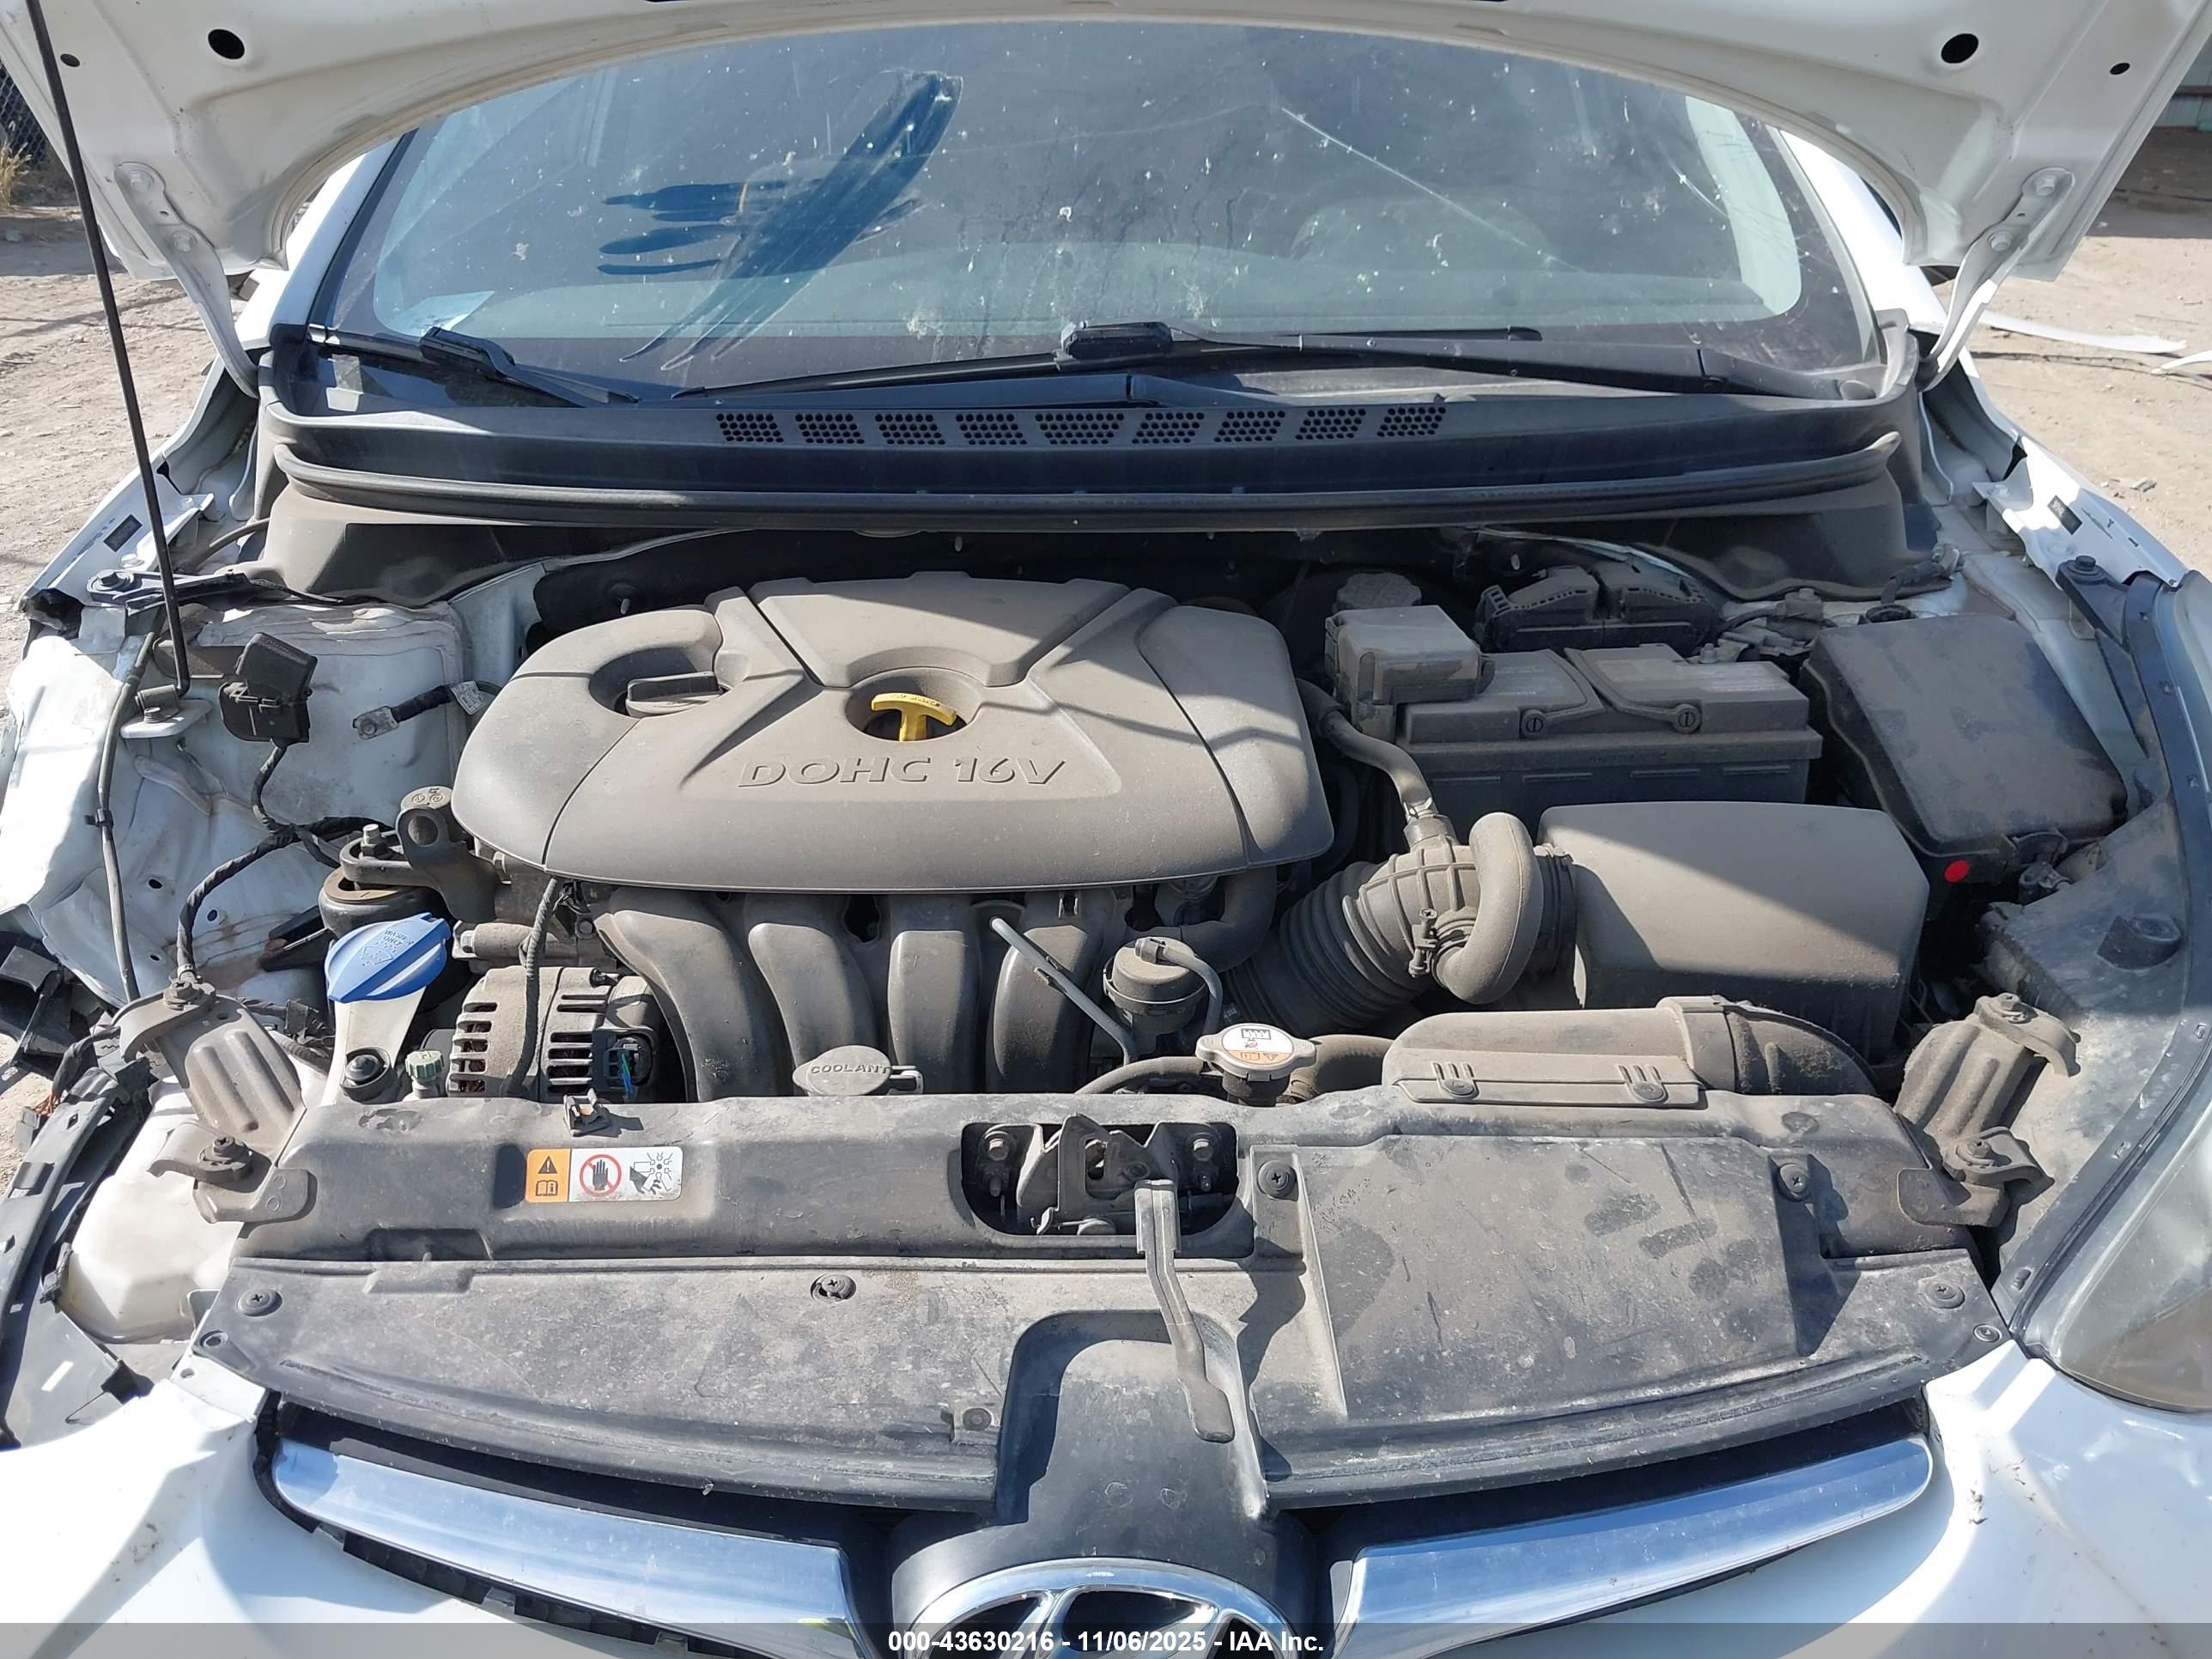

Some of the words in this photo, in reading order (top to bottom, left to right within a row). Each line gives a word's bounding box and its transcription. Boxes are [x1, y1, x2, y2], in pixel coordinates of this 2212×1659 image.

[738, 756, 931, 787] DOHC
[954, 756, 1066, 785] 16V
[810, 1064, 892, 1074] COOLANT
